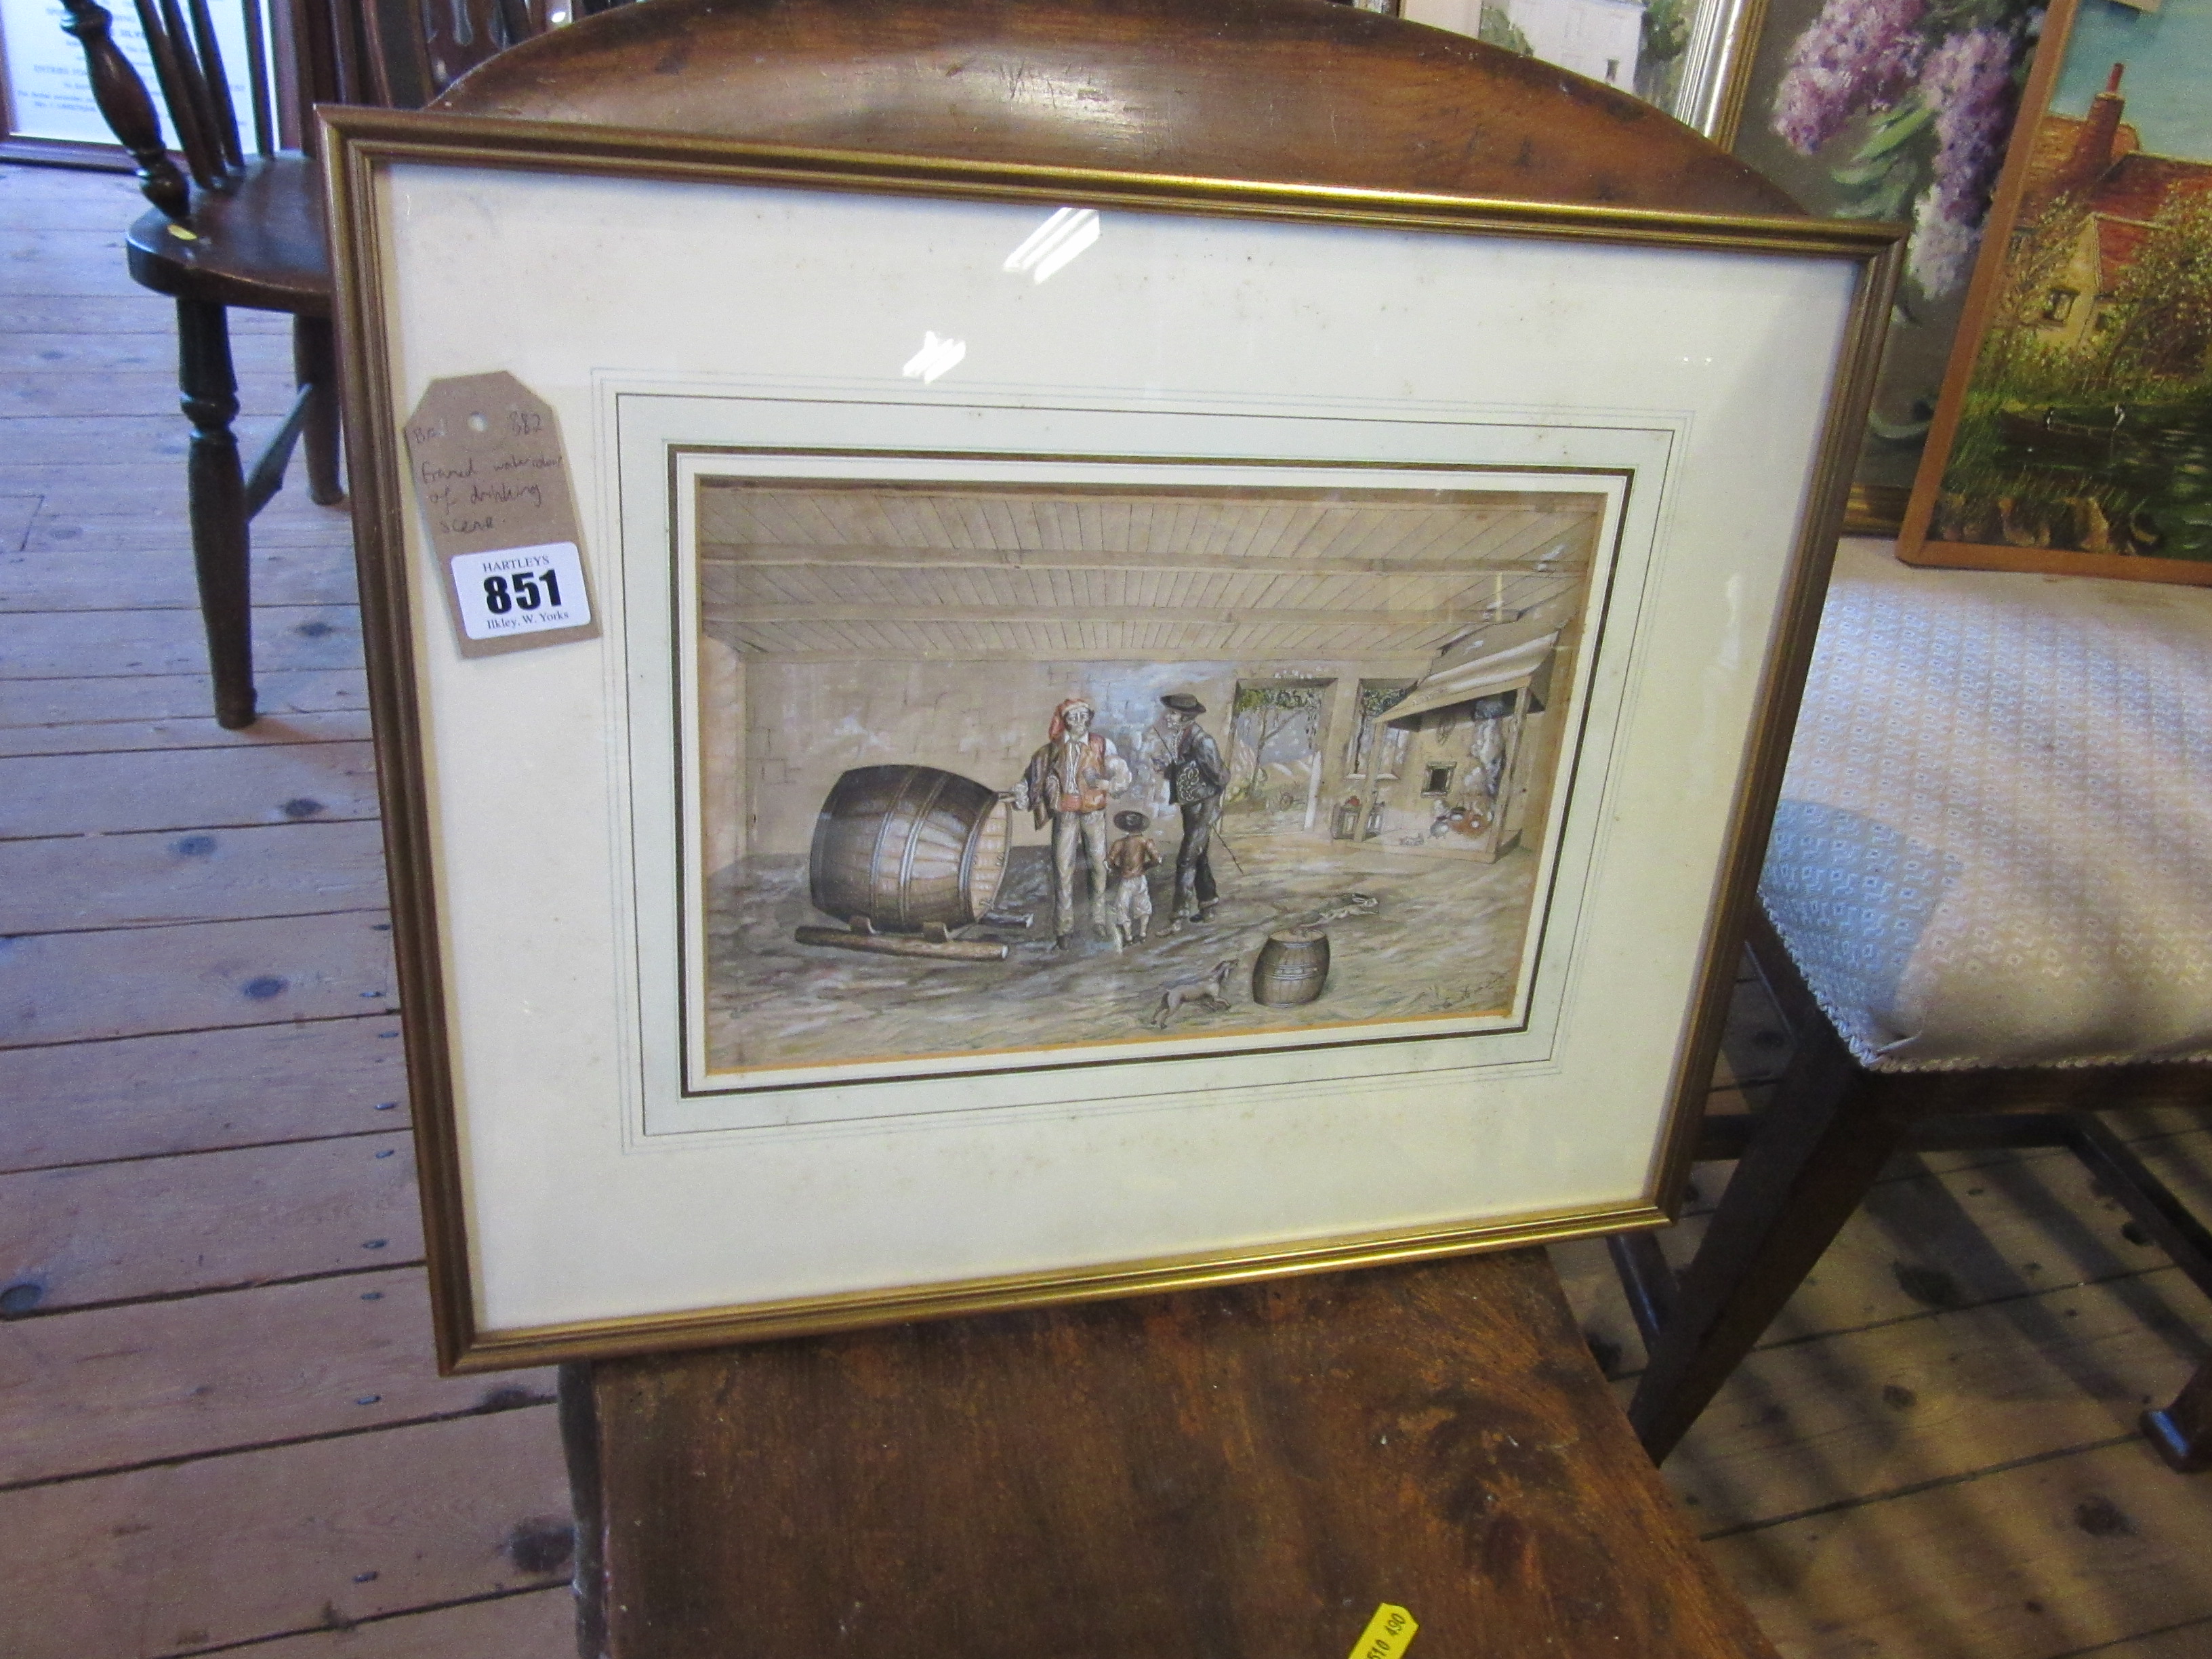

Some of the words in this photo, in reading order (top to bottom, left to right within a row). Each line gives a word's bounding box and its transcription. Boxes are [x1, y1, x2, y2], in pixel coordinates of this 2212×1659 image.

[483, 555, 550, 573] HARTLEYS
[483, 569, 562, 615] 851
[523, 615, 537, 625] W.
[539, 611, 569, 622] Yorks
